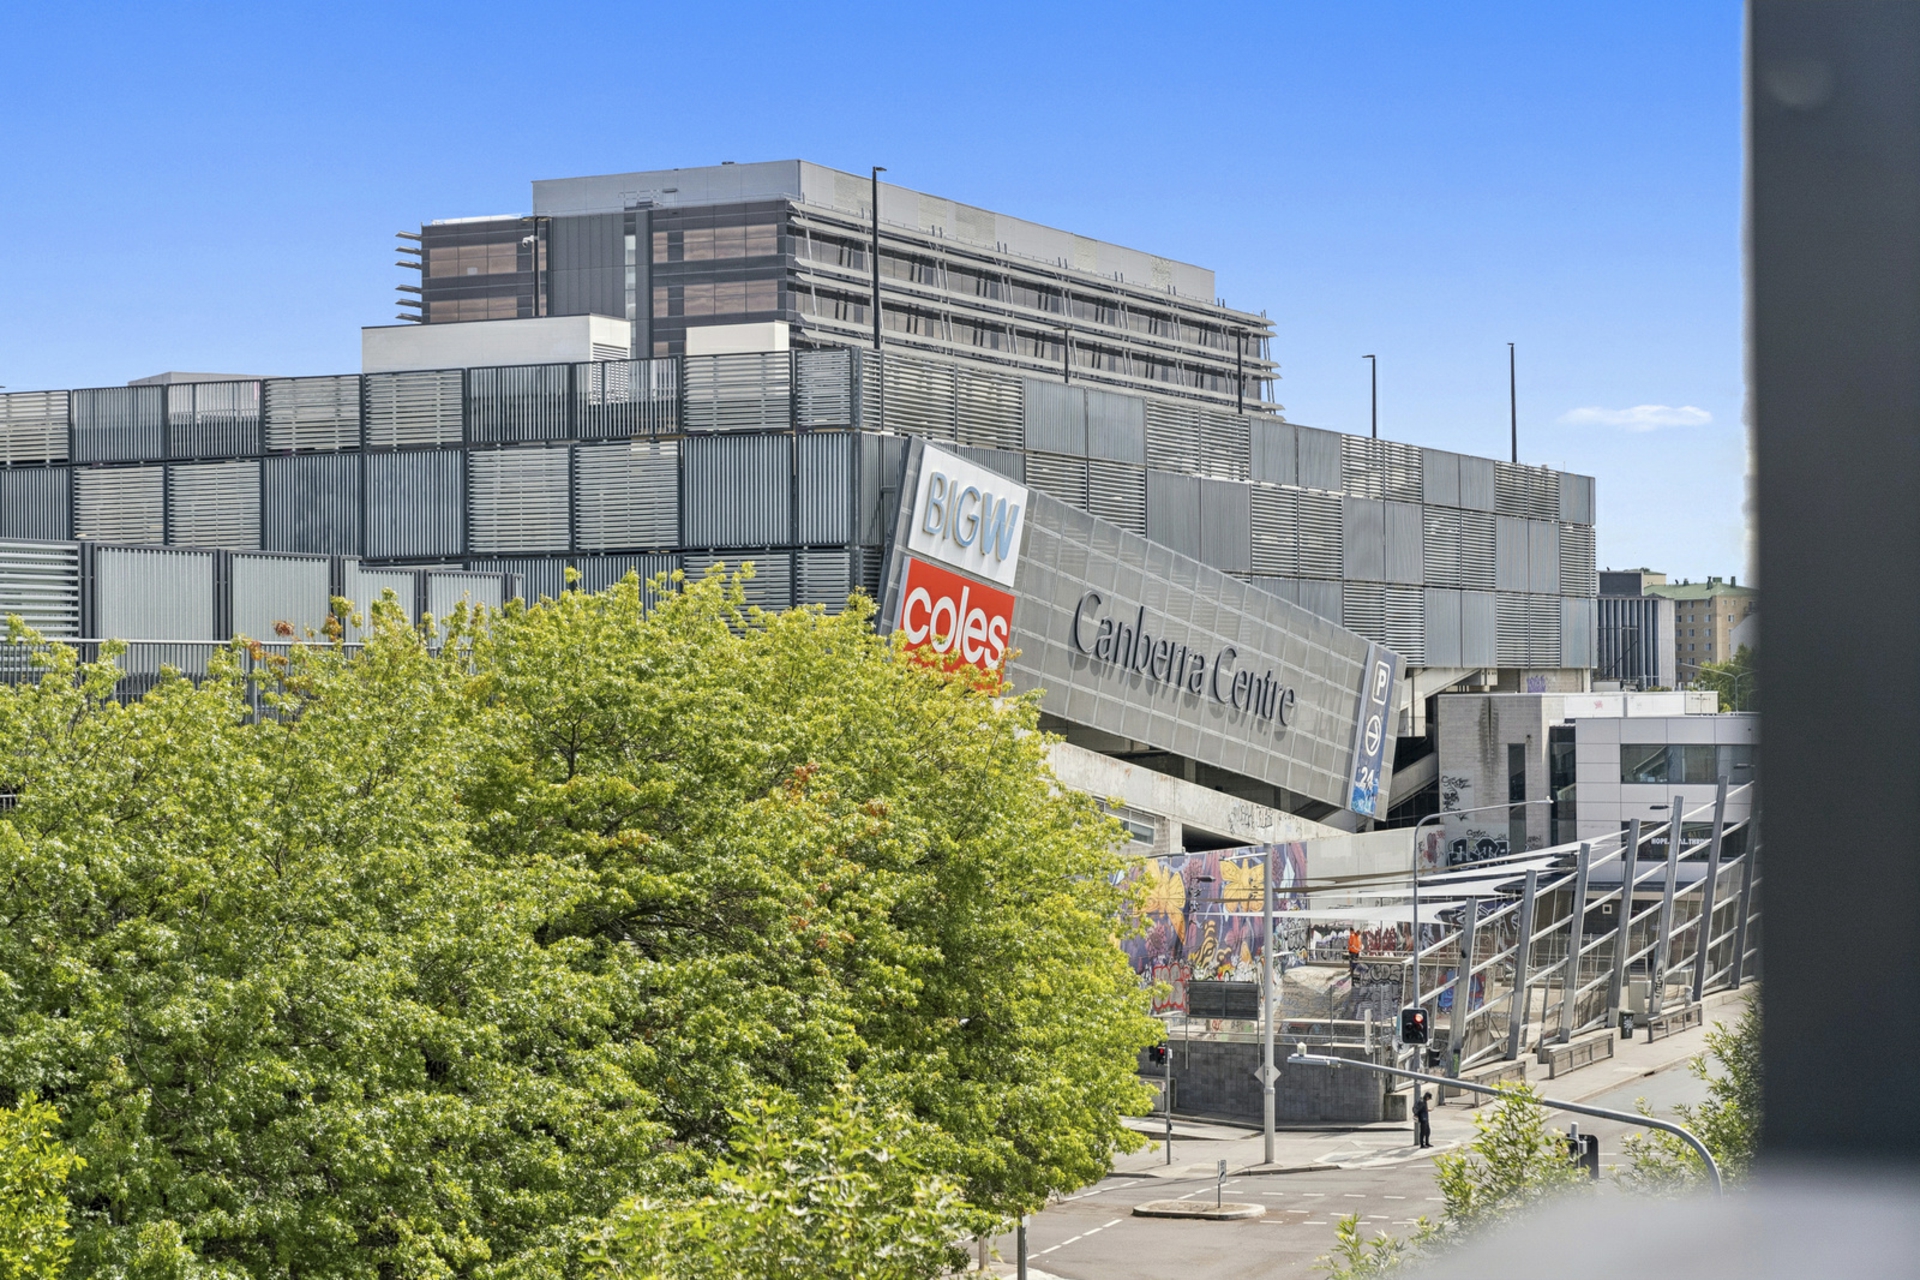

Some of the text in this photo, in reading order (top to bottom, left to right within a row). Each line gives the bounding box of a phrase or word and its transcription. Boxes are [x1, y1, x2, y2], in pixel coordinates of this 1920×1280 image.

[903, 585, 1008, 670] coles
[1074, 590, 1295, 727] Canberra Centre
[1376, 669, 1387, 696] P
